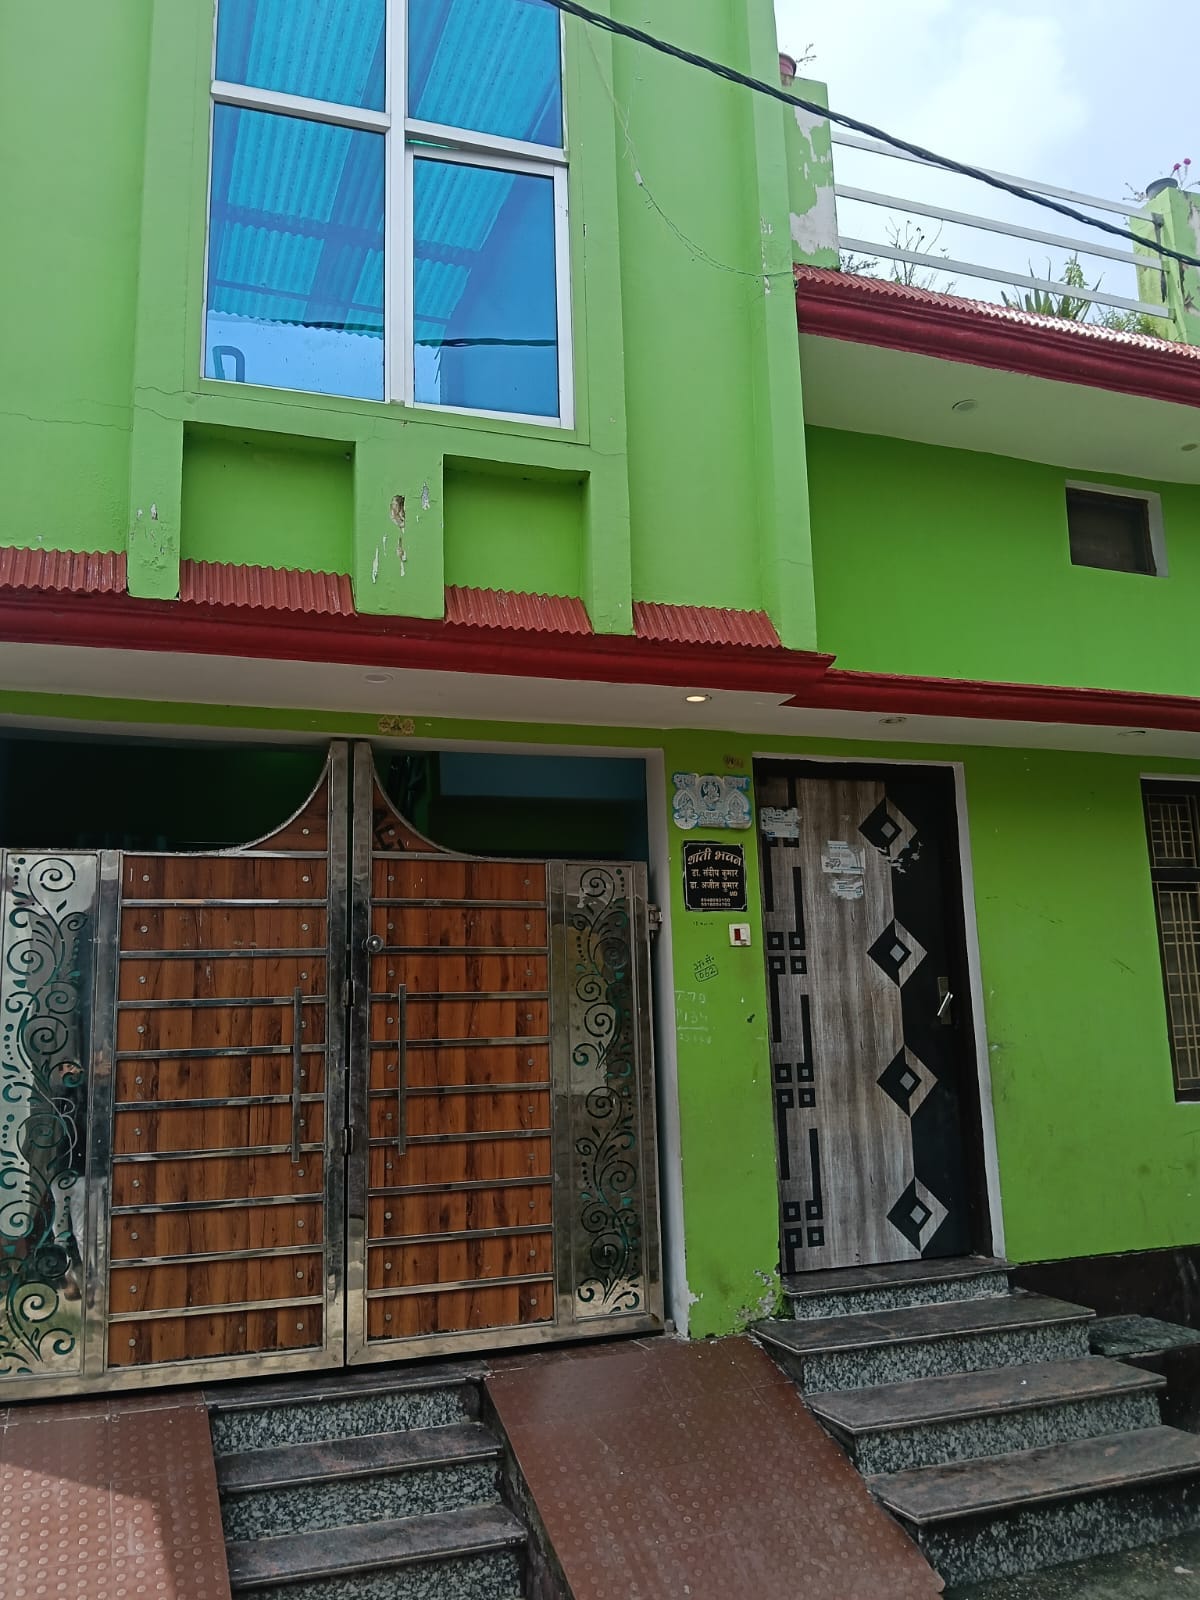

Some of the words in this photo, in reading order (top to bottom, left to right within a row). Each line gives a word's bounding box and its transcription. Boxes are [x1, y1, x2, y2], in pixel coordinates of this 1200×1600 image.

[714, 851, 742, 866] भवन
[721, 869, 739, 880] कुमार
[721, 881, 739, 892] कुमार
